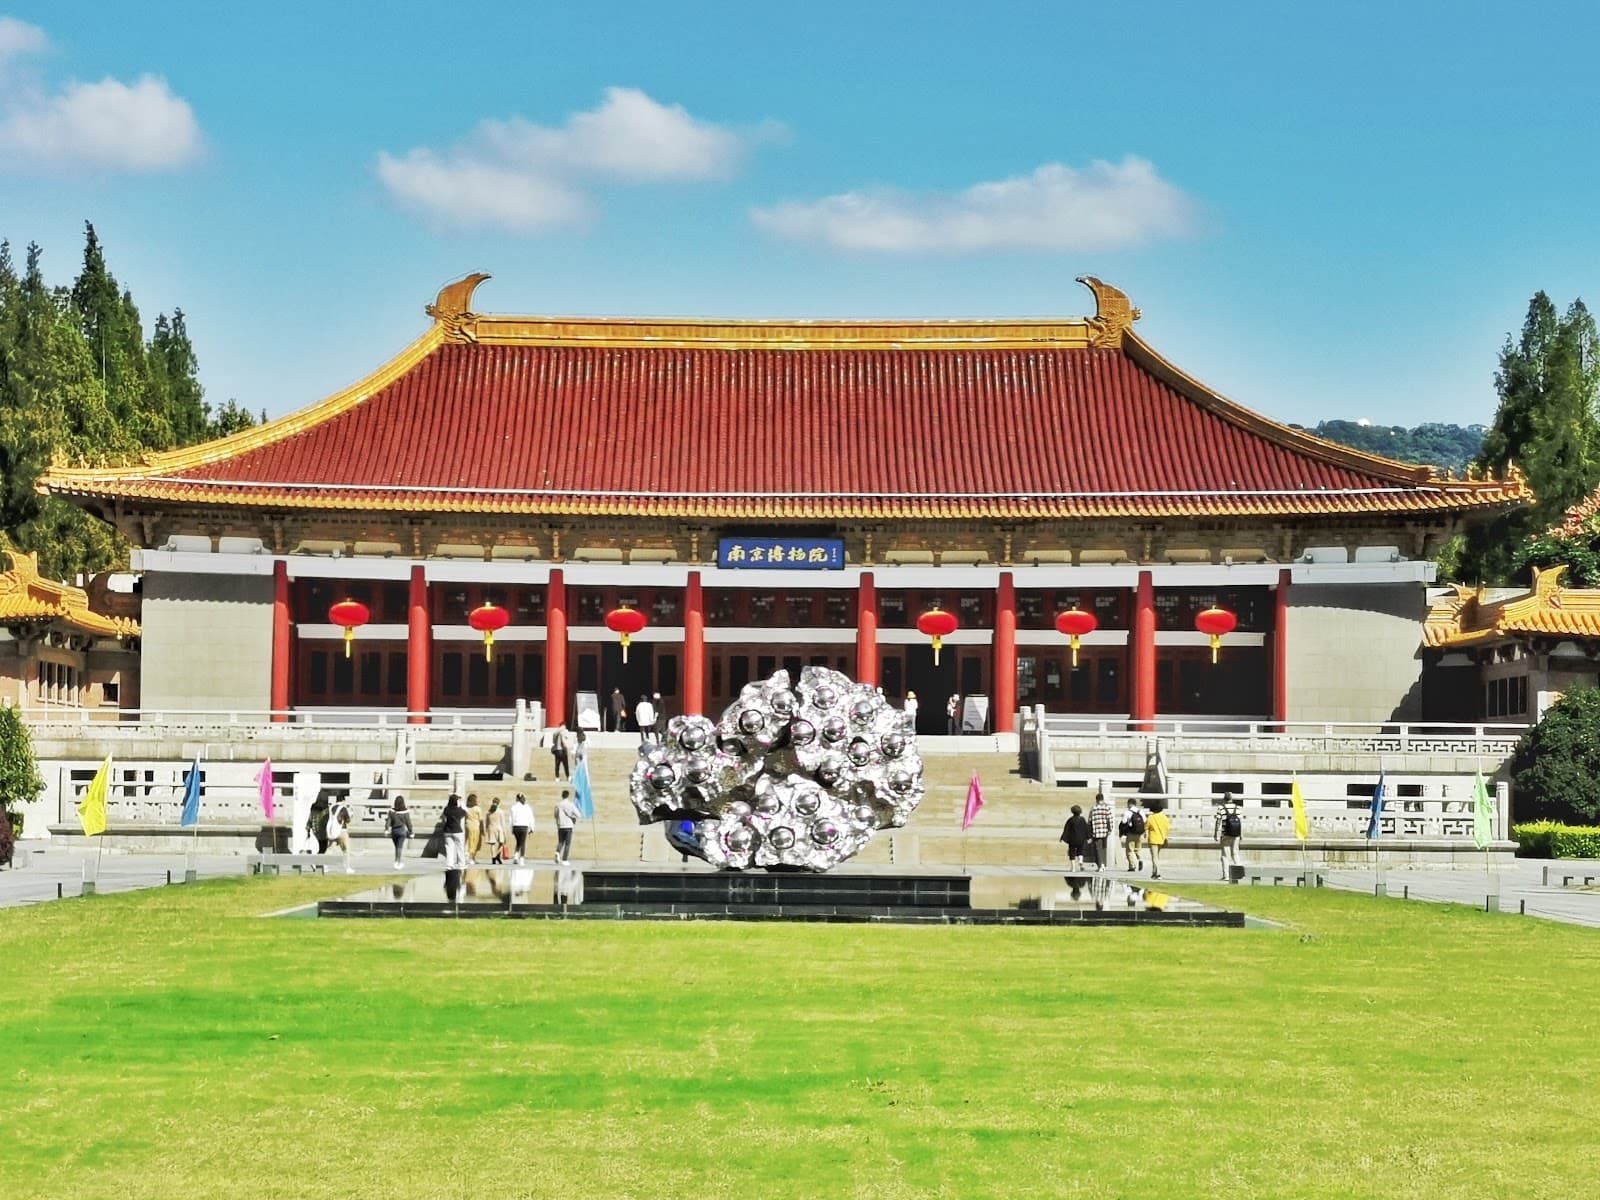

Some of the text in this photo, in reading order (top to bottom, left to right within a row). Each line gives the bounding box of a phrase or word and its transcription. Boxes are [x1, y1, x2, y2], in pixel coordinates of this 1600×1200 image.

[727, 545, 828, 563] 南京博物院
